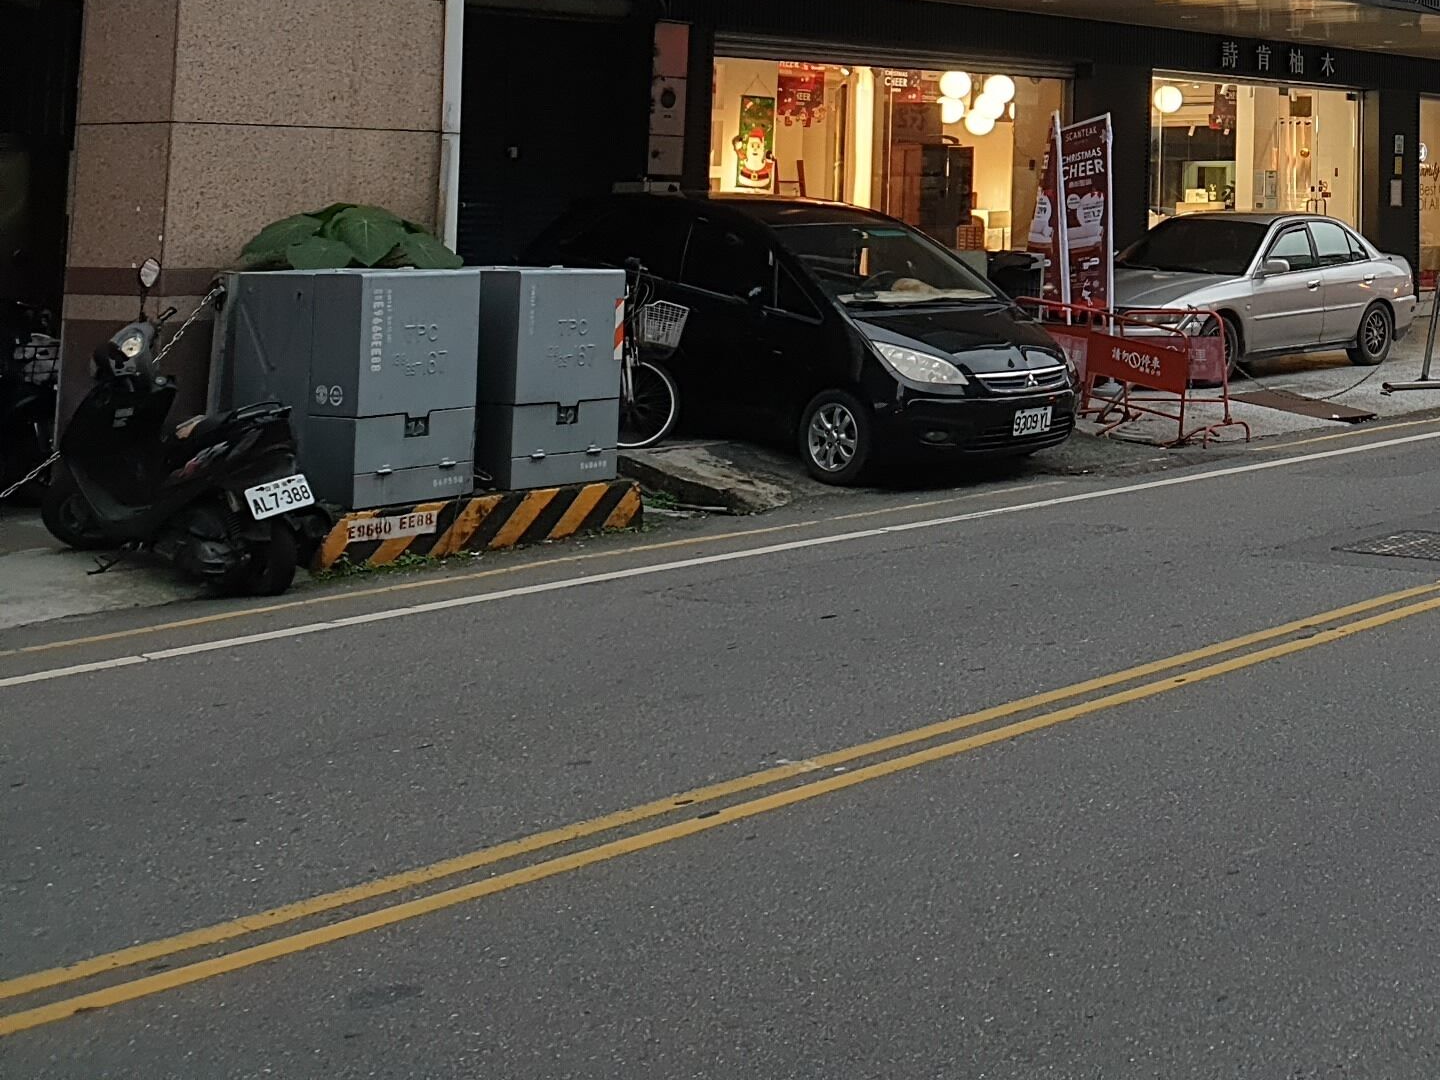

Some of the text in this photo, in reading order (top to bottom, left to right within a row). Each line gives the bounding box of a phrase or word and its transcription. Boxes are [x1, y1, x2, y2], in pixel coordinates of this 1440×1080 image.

[1222, 41, 1335, 77] 詩肯柚木
[1065, 126, 1098, 143] SCANTEAK
[1061, 147, 1103, 166] CHRISTMAS
[1062, 159, 1105, 180] CHEER
[252, 485, 311, 515] AL7-388
